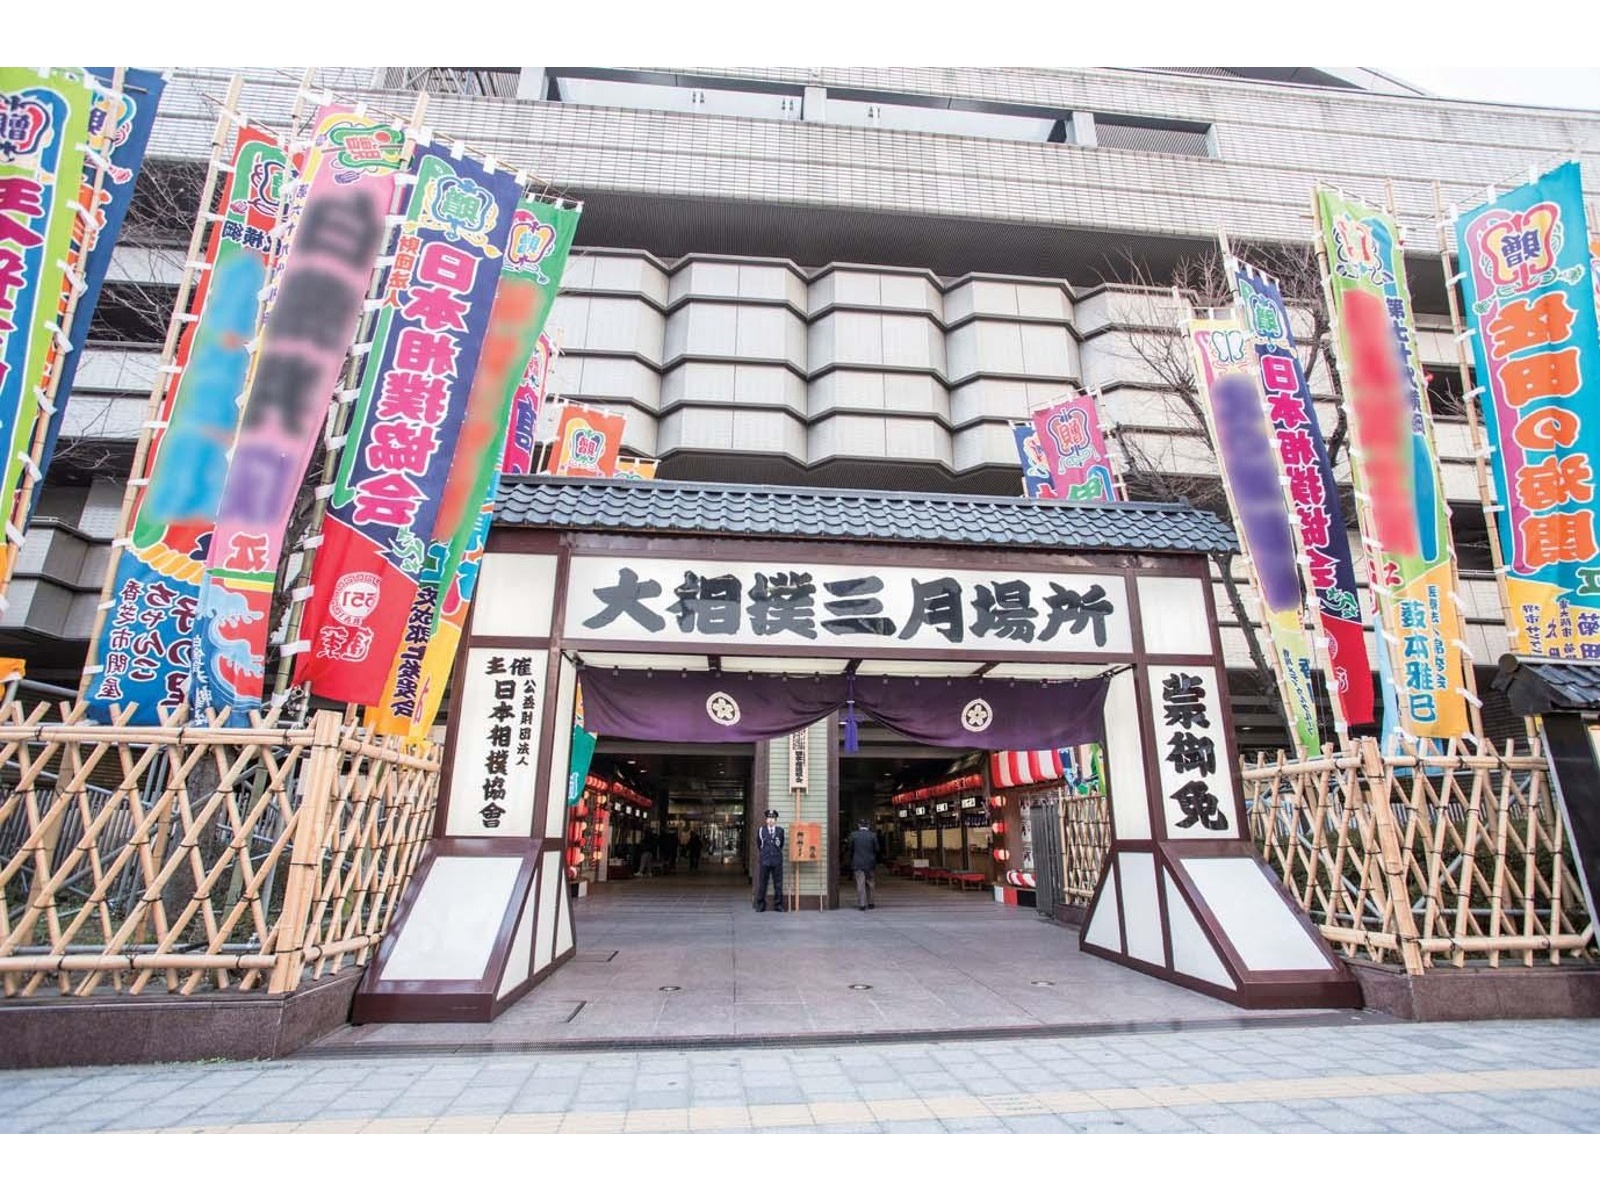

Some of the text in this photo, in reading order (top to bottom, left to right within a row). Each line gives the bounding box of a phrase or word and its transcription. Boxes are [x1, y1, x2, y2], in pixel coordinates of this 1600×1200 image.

[582, 567, 1114, 647] 大相撲三月場所
[485, 656, 532, 676] 主催
[515, 680, 536, 766] 公益財団法人
